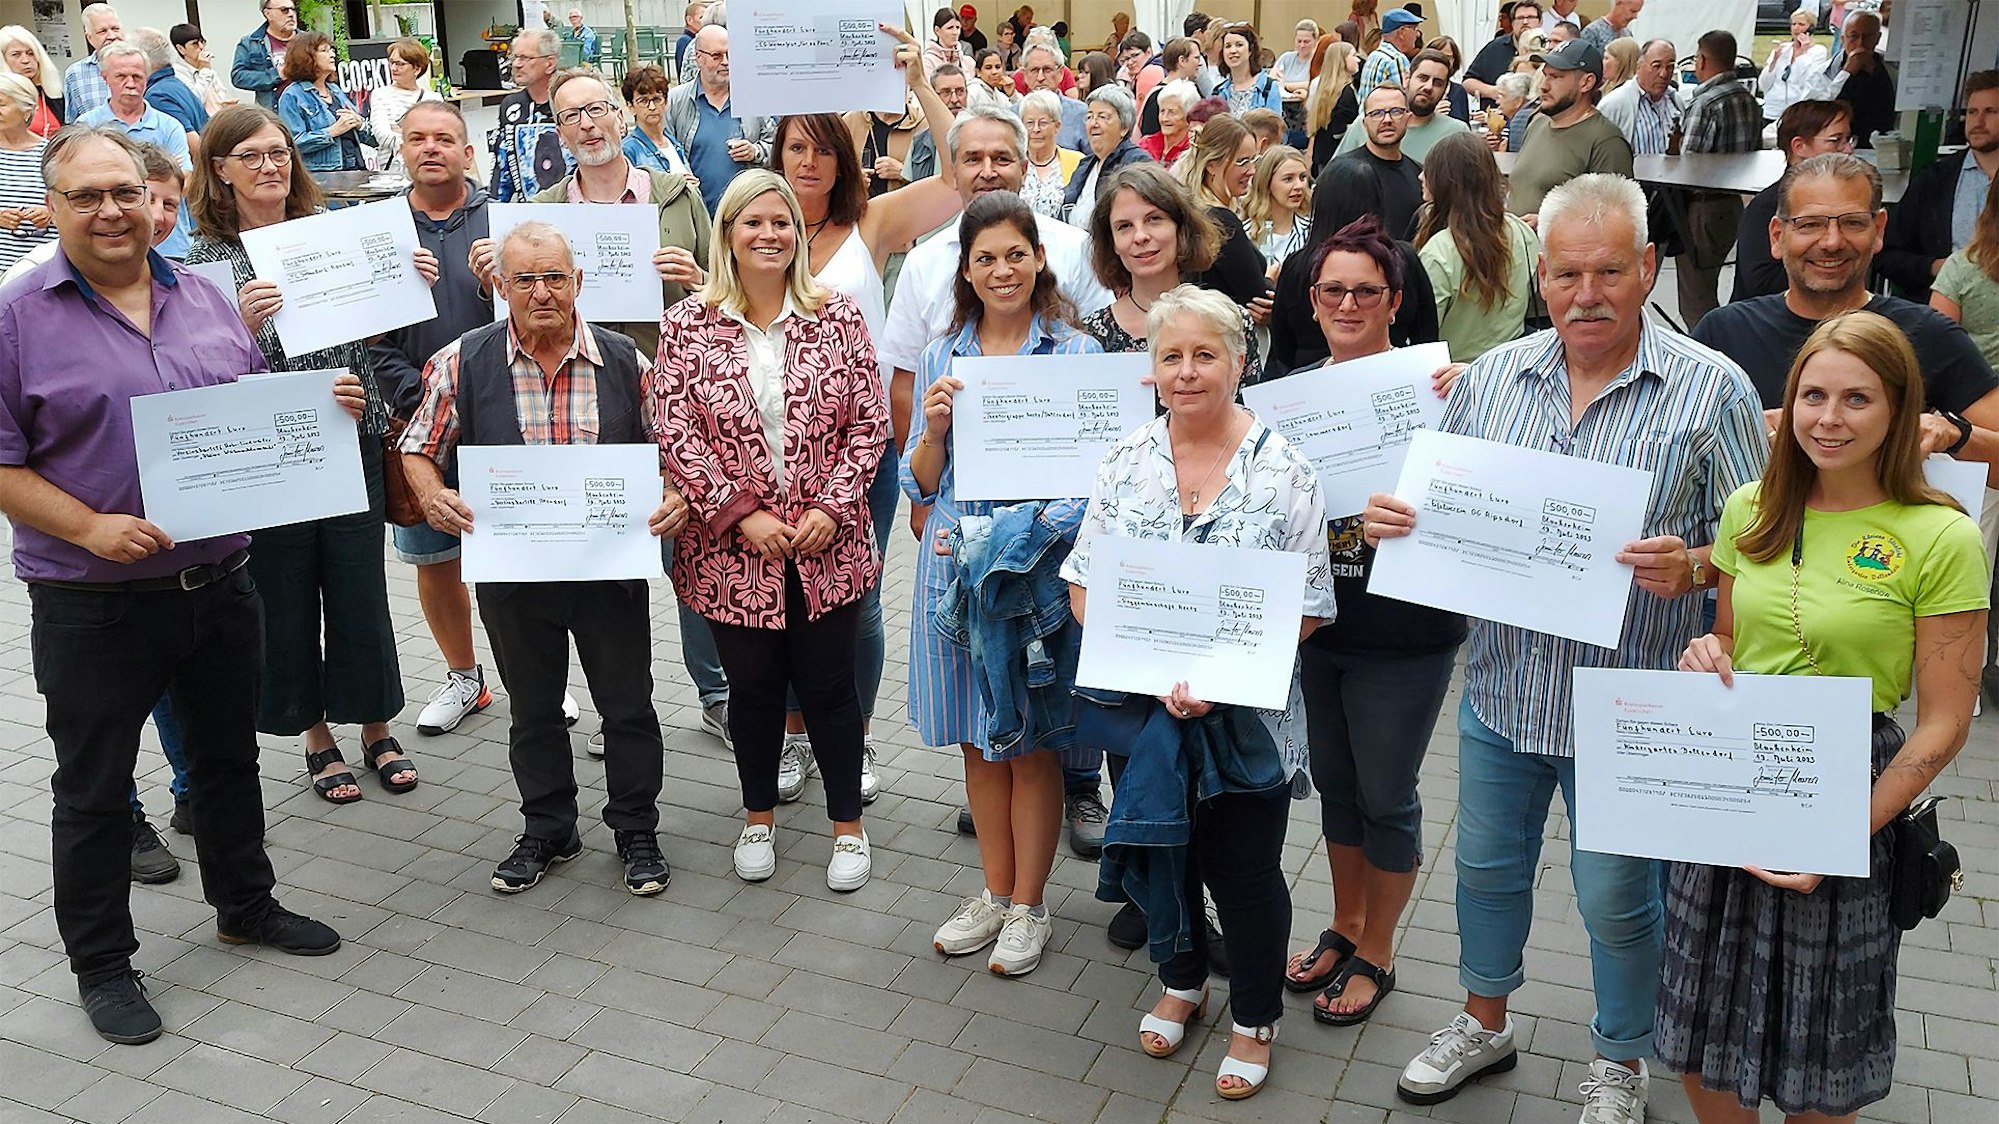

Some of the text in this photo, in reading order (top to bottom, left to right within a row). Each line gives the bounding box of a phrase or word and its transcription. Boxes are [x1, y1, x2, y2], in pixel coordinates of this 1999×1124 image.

[1332, 563, 1364, 577] SEIN
[1689, 727, 1713, 736] Euro
[1753, 742, 1813, 752] Blankenheim
[1773, 754, 1794, 763] Juli
